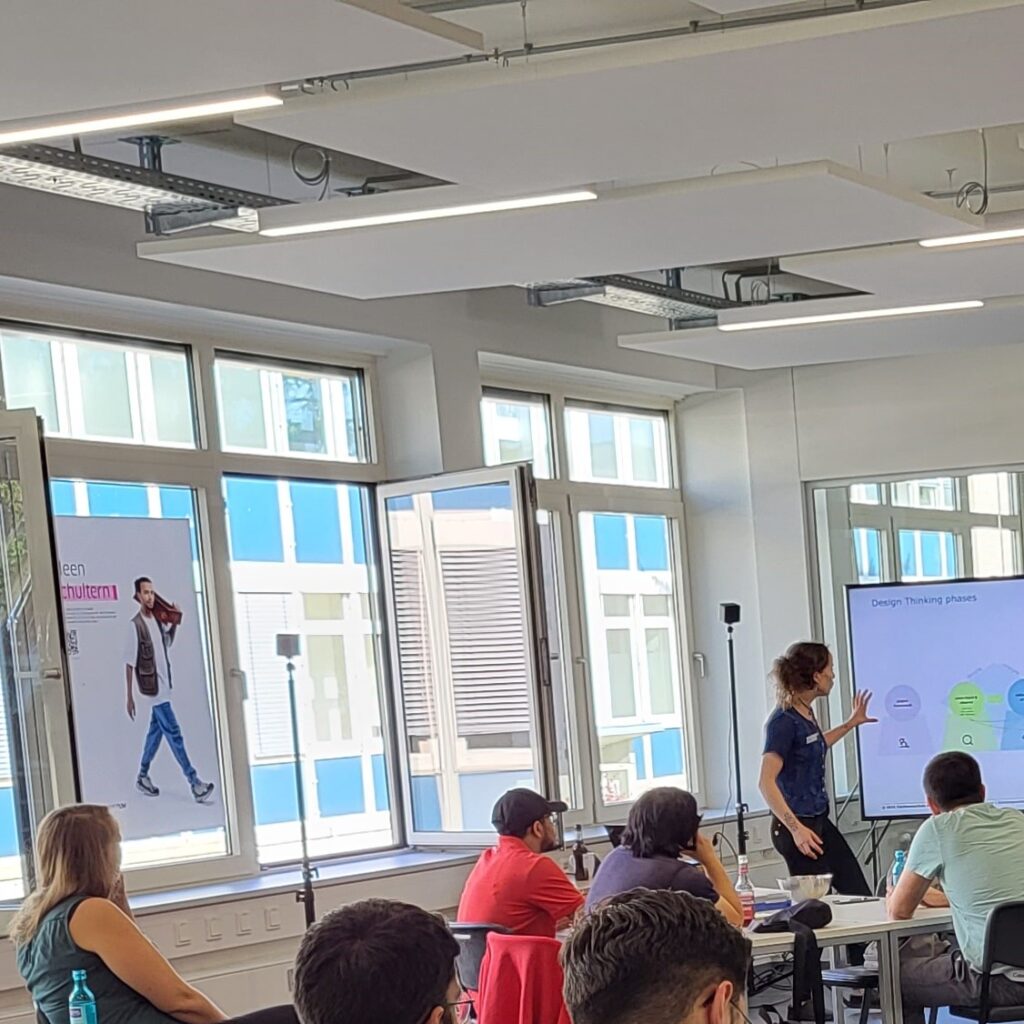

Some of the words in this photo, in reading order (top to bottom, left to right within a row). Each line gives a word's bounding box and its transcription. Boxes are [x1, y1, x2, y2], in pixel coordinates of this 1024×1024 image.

[59, 561, 86, 576] een
[61, 582, 110, 600] chultern
[872, 598, 902, 608] Design
[905, 596, 943, 605] Thinking
[946, 594, 977, 605] phases
